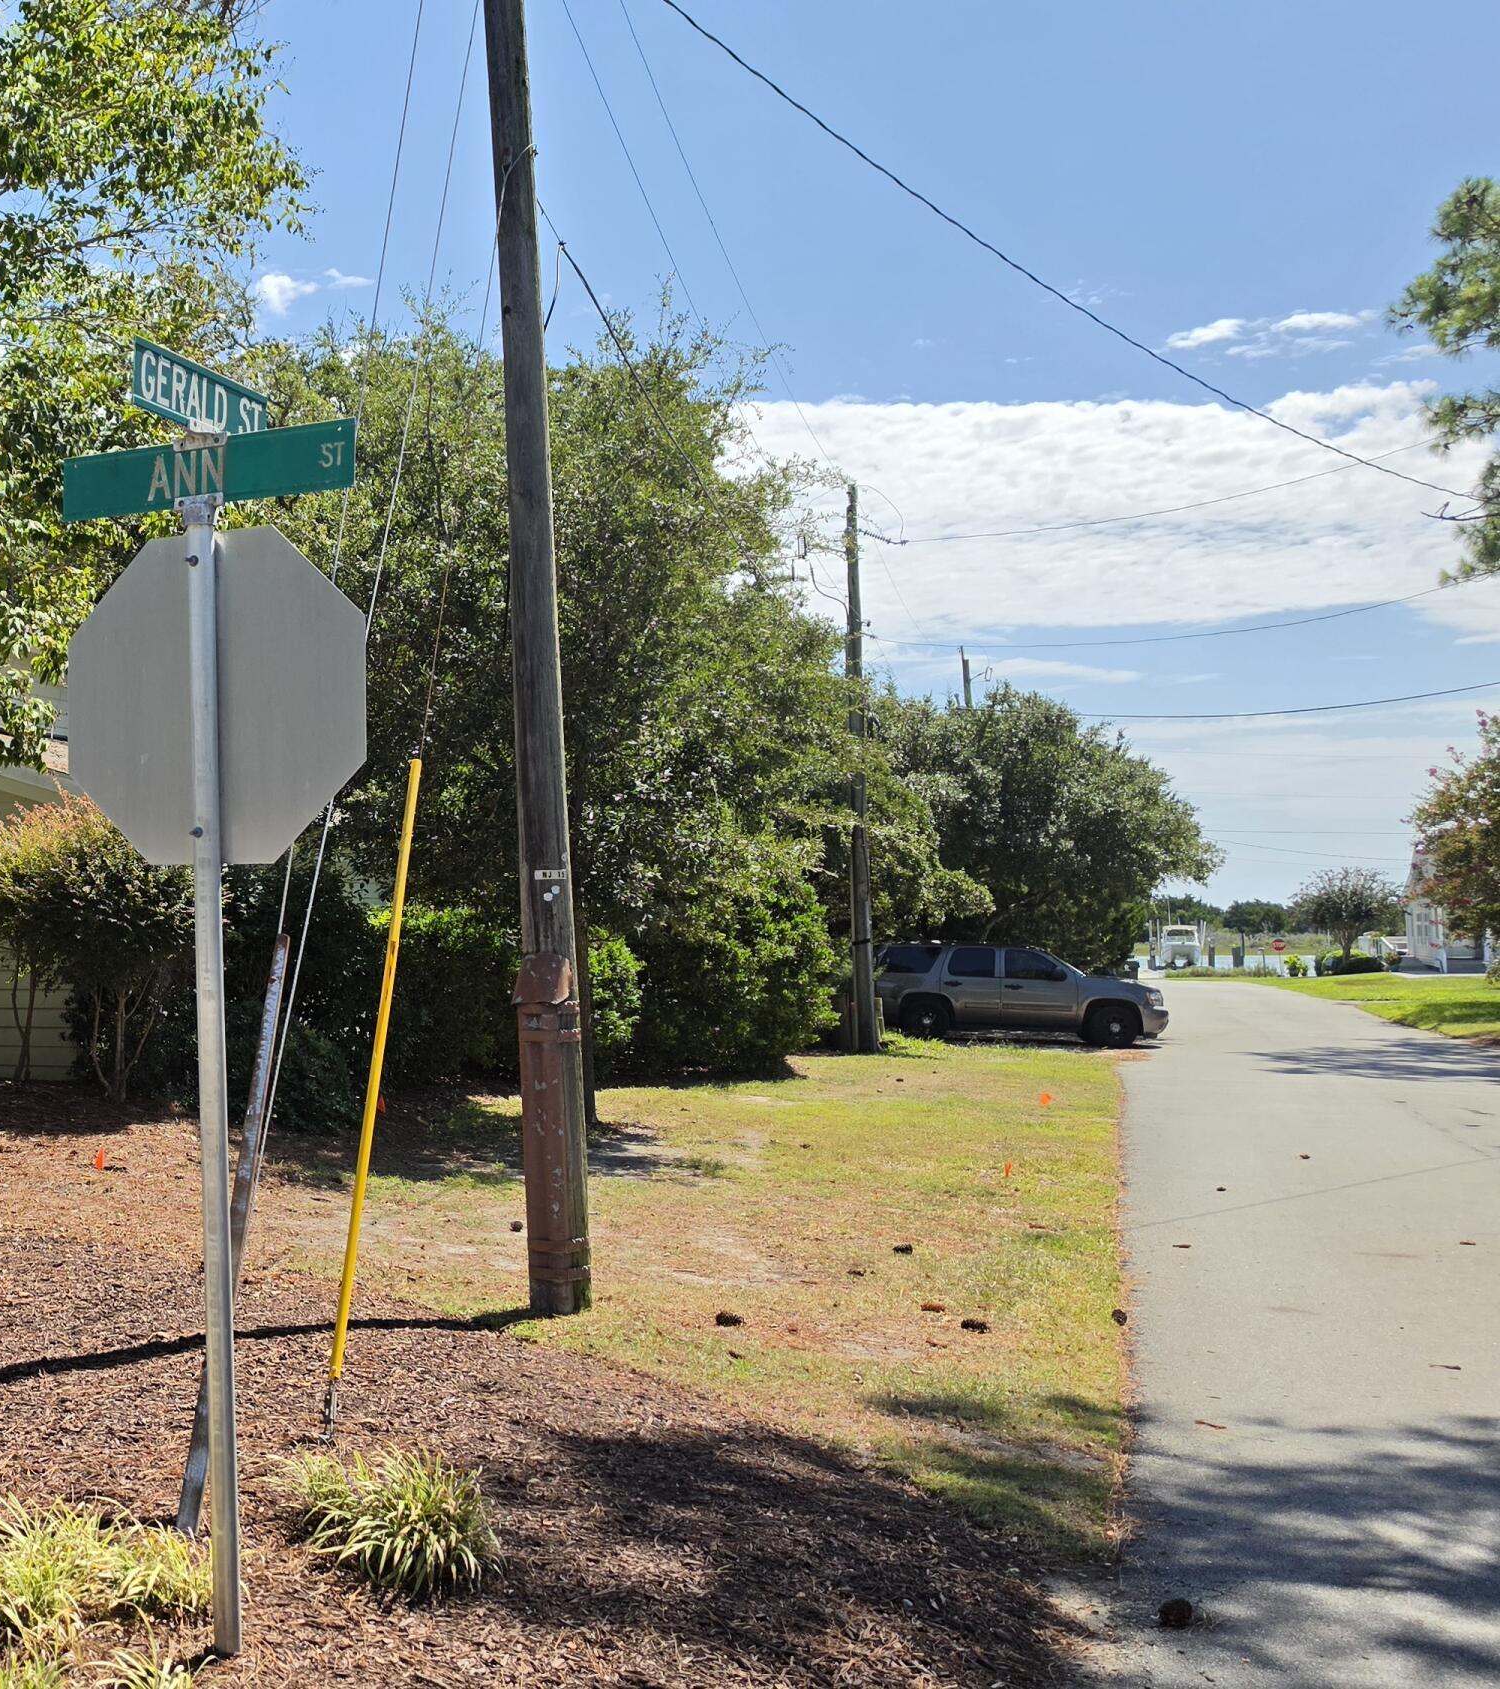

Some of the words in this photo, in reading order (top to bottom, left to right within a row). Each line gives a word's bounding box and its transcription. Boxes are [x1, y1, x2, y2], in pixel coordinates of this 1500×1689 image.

[141, 351, 228, 431] GERALD
[239, 399, 263, 432] ST
[147, 446, 224, 501] ANN
[318, 440, 346, 468] ST
